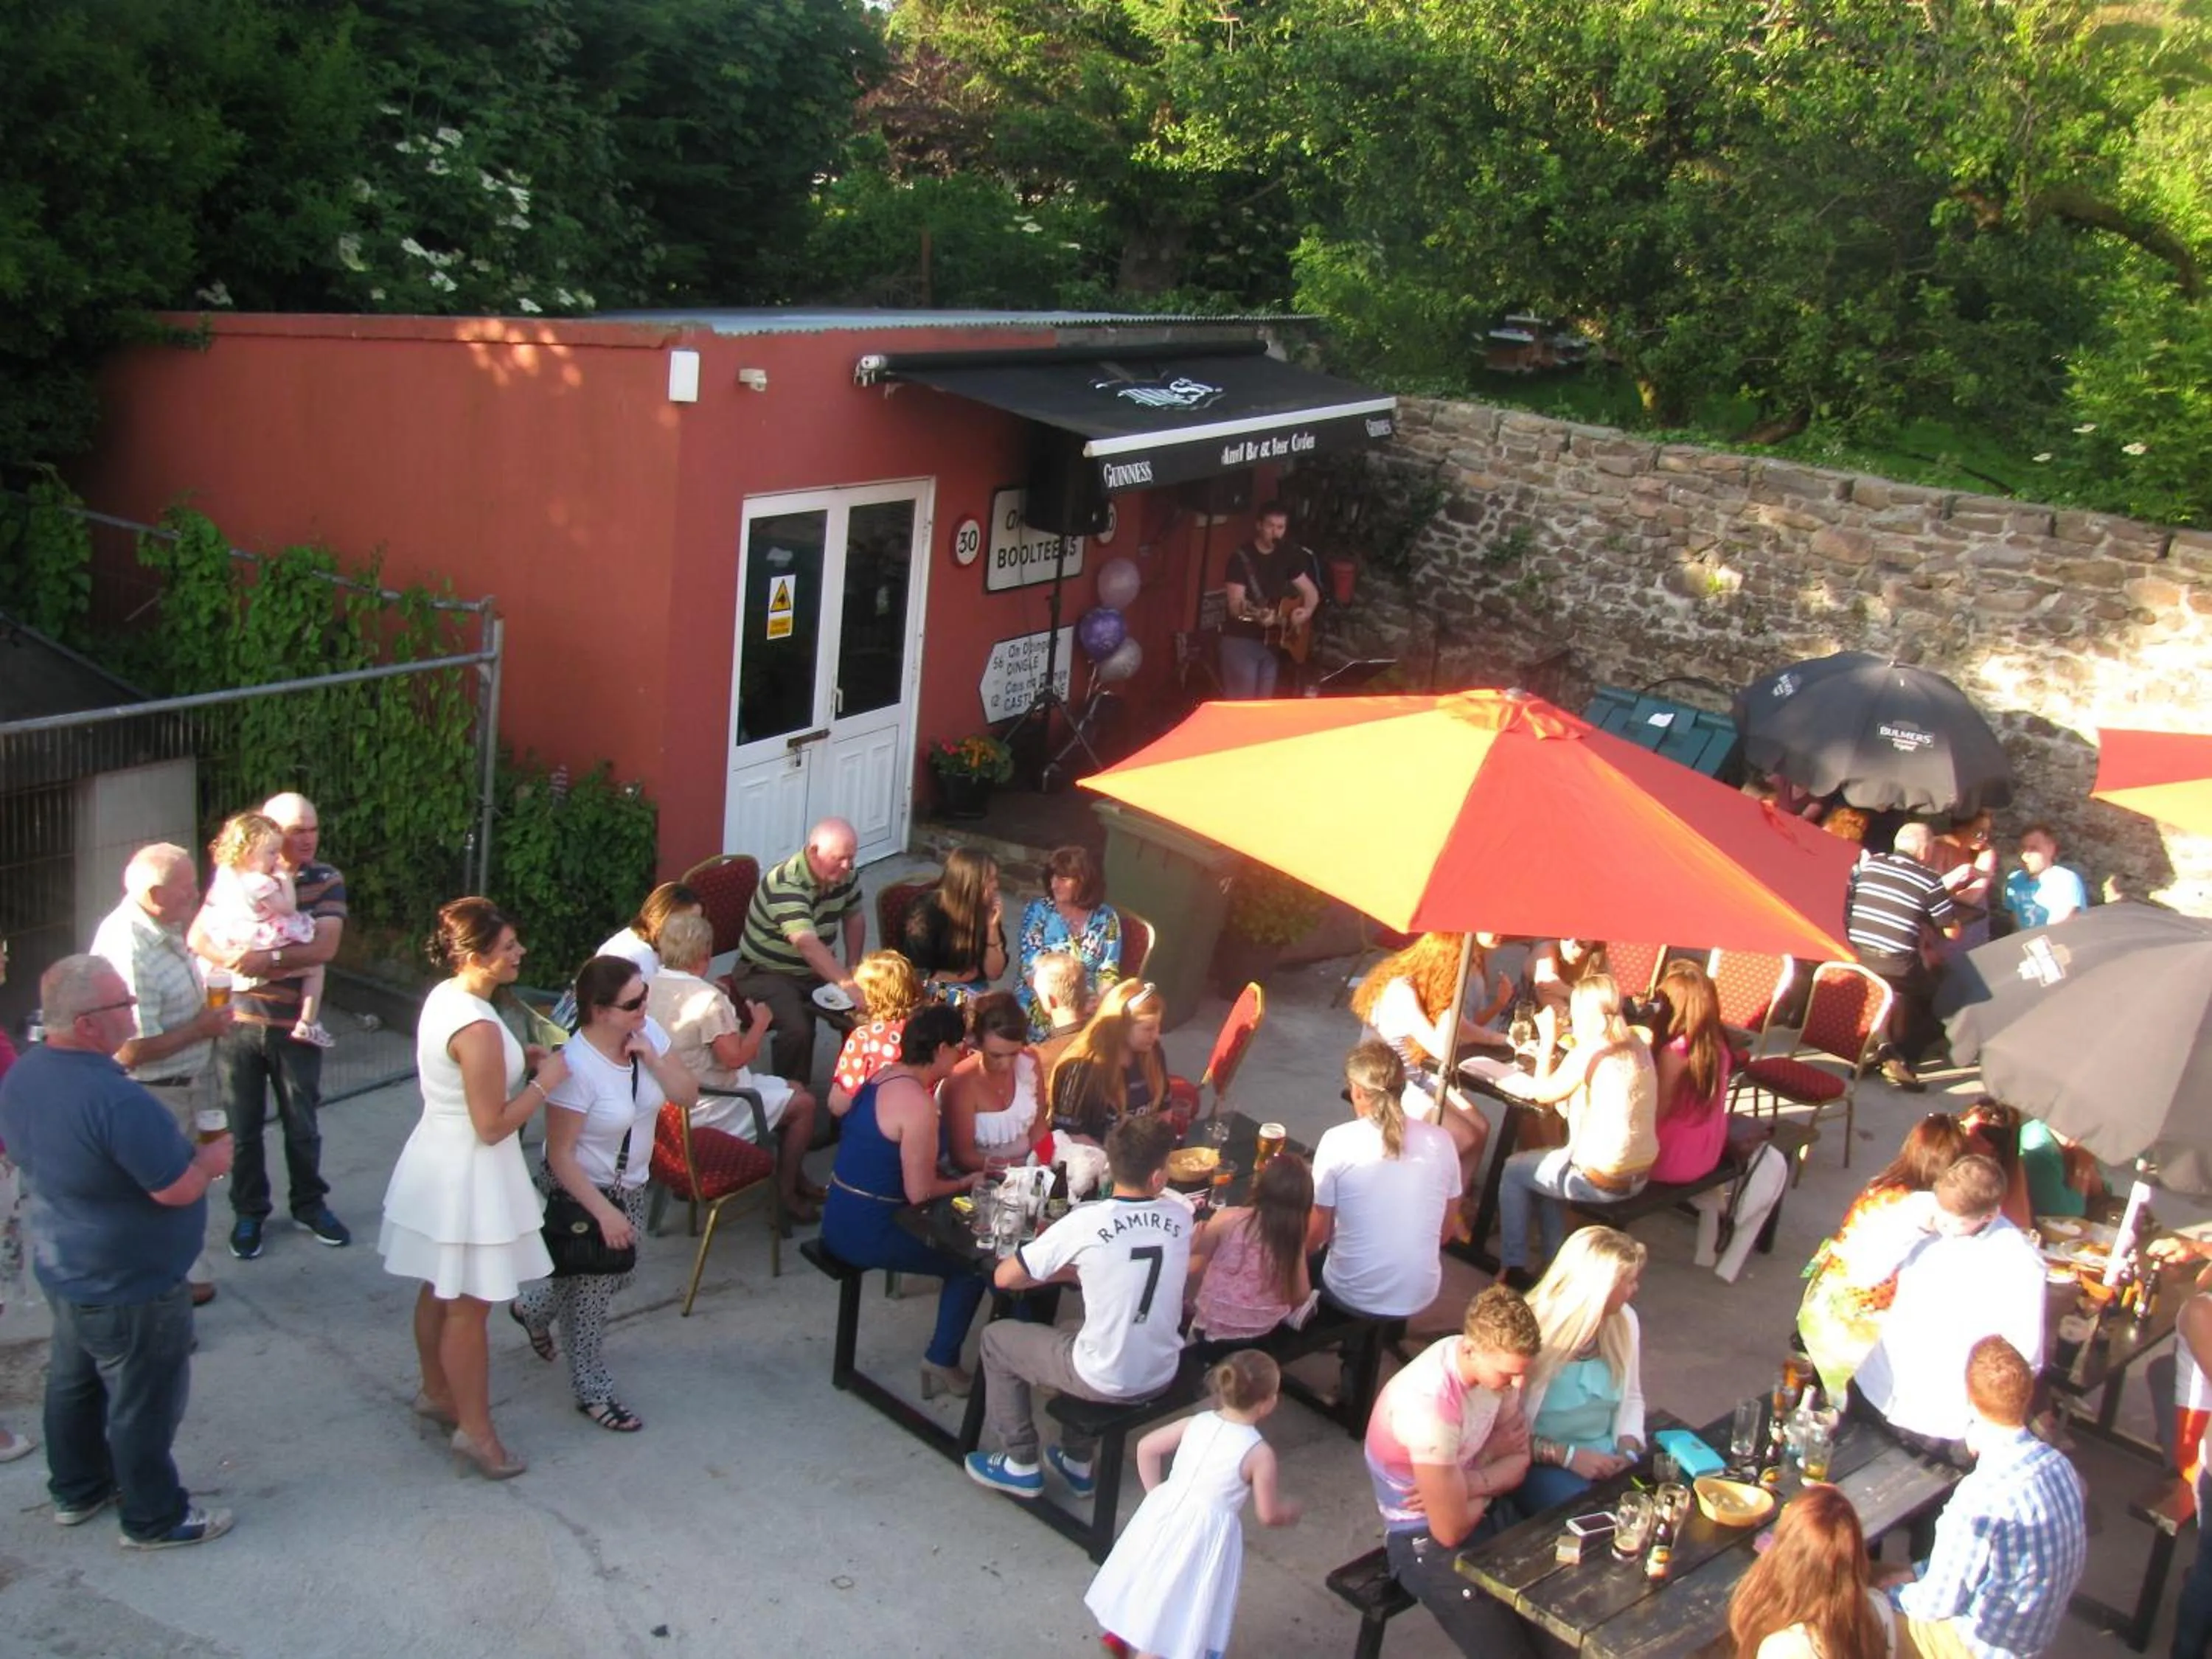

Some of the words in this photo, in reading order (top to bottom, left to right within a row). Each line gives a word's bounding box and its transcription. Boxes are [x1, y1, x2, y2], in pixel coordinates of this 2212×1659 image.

[1103, 460, 1152, 487] GUINNESS
[959, 530, 978, 554] 30
[1880, 726, 1933, 745] BULMERS
[1097, 1212, 1182, 1243] RAMIRES
[1129, 1245, 1164, 1324] 7
